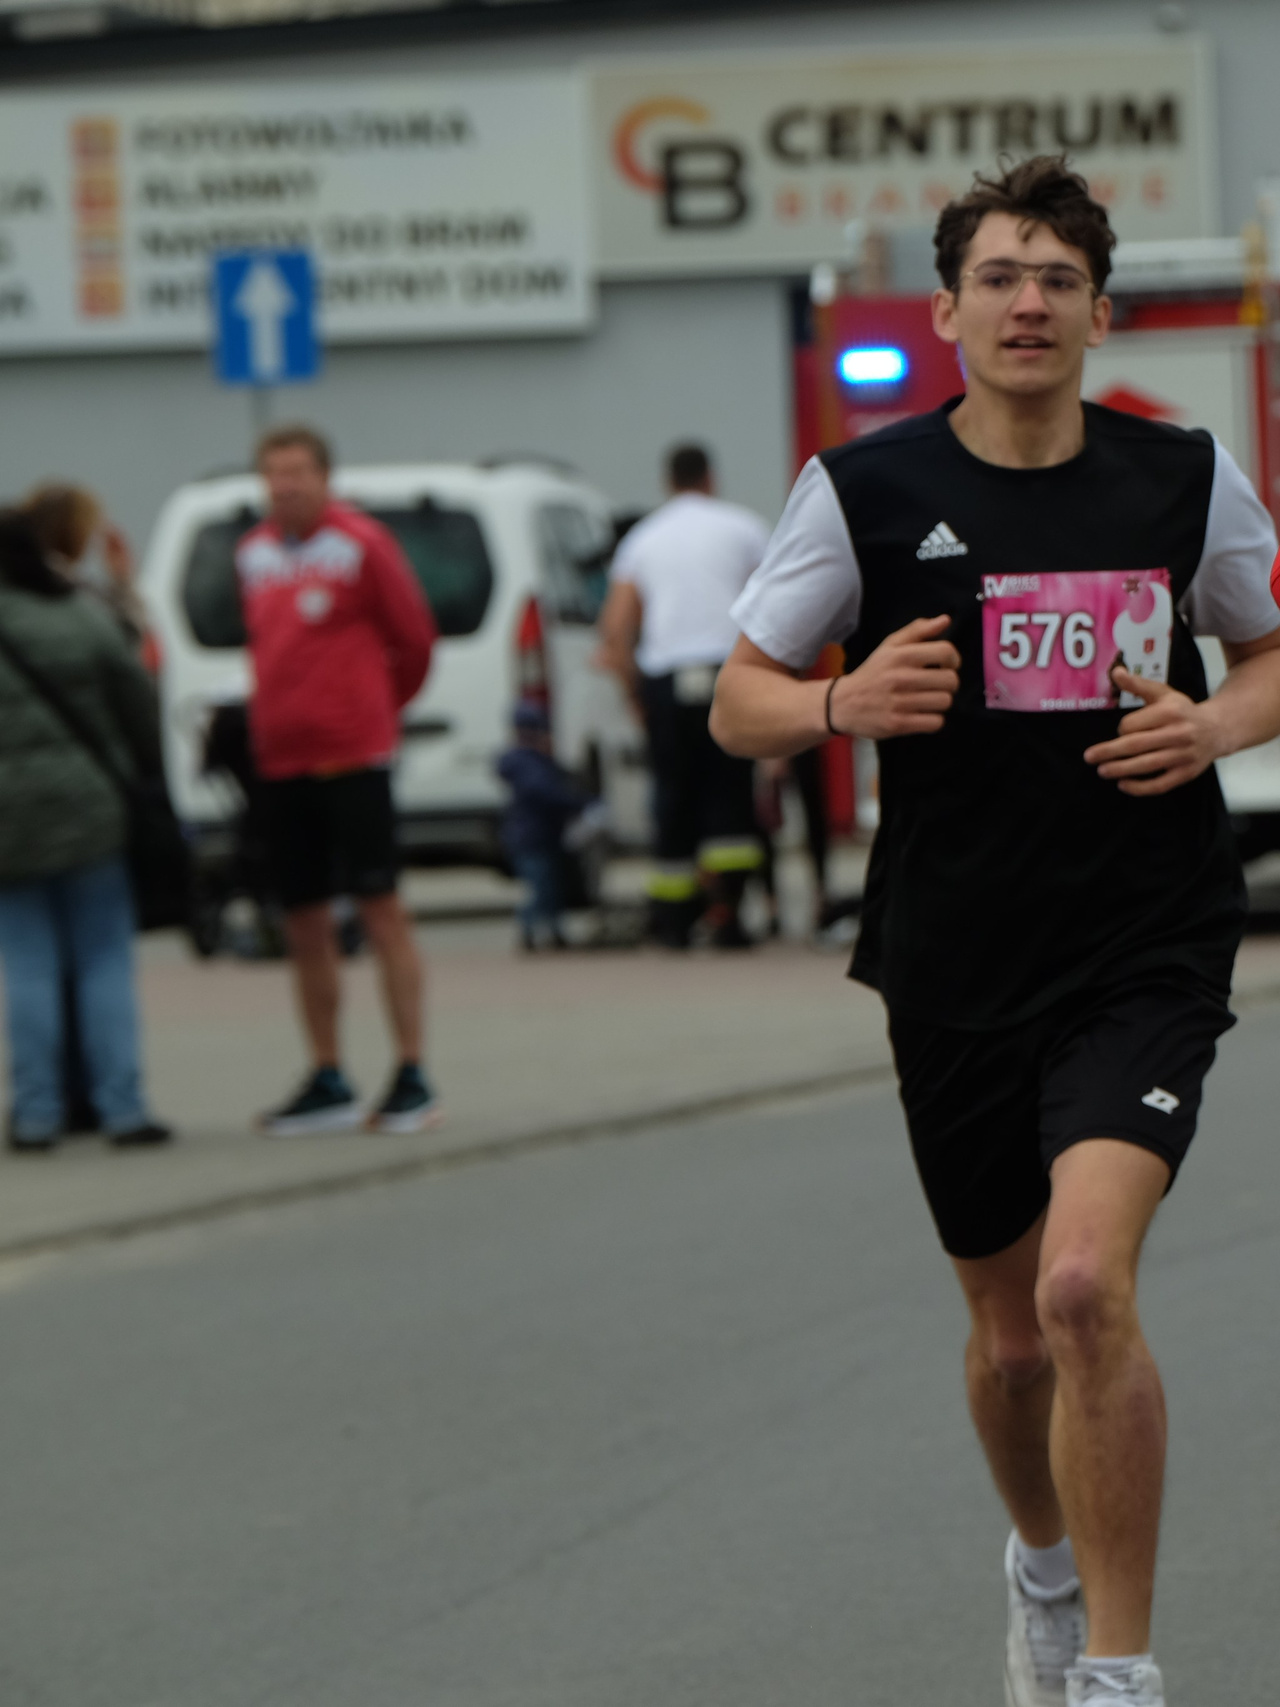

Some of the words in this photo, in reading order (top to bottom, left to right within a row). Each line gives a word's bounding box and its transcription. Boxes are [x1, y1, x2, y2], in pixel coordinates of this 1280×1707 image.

[766, 94, 1182, 166] CENTRUM
[916, 542, 968, 560] adidas
[999, 611, 1096, 670] 576
